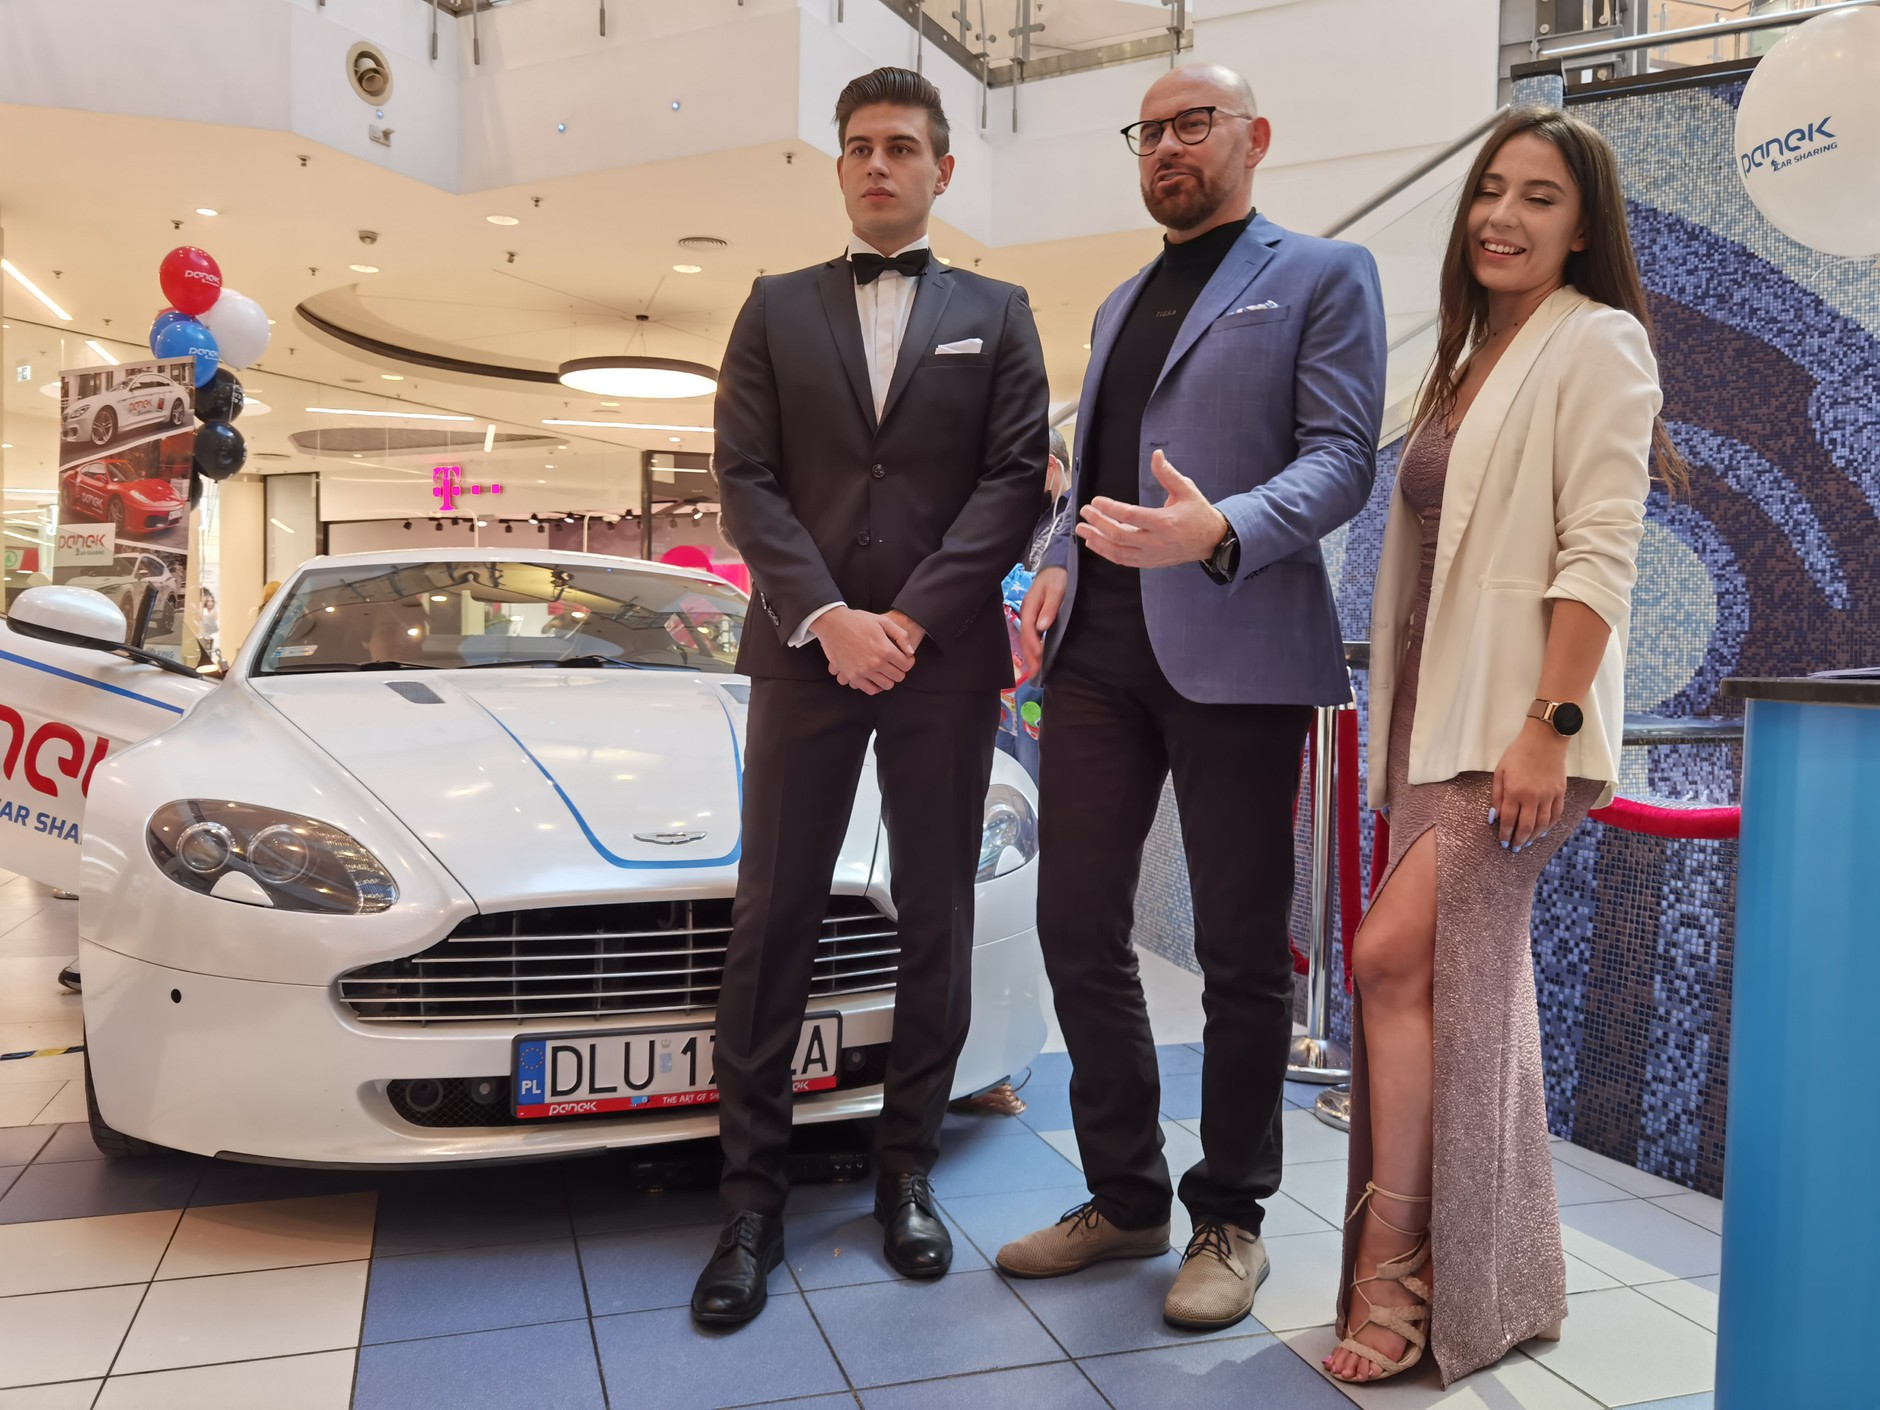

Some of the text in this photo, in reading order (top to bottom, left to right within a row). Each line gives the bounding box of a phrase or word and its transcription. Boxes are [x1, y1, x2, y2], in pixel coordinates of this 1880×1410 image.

[1741, 115, 1836, 179] panek
[1775, 141, 1838, 172] CAR SHARING
[58, 534, 106, 552] panek
[0, 799, 82, 846] AR SHA
[550, 1039, 656, 1098] DLU
[521, 1080, 541, 1095] PL
[549, 1101, 597, 1116] panek
[662, 1096, 678, 1105] THE
[679, 1094, 695, 1104] ART
[696, 1092, 707, 1102] OF
